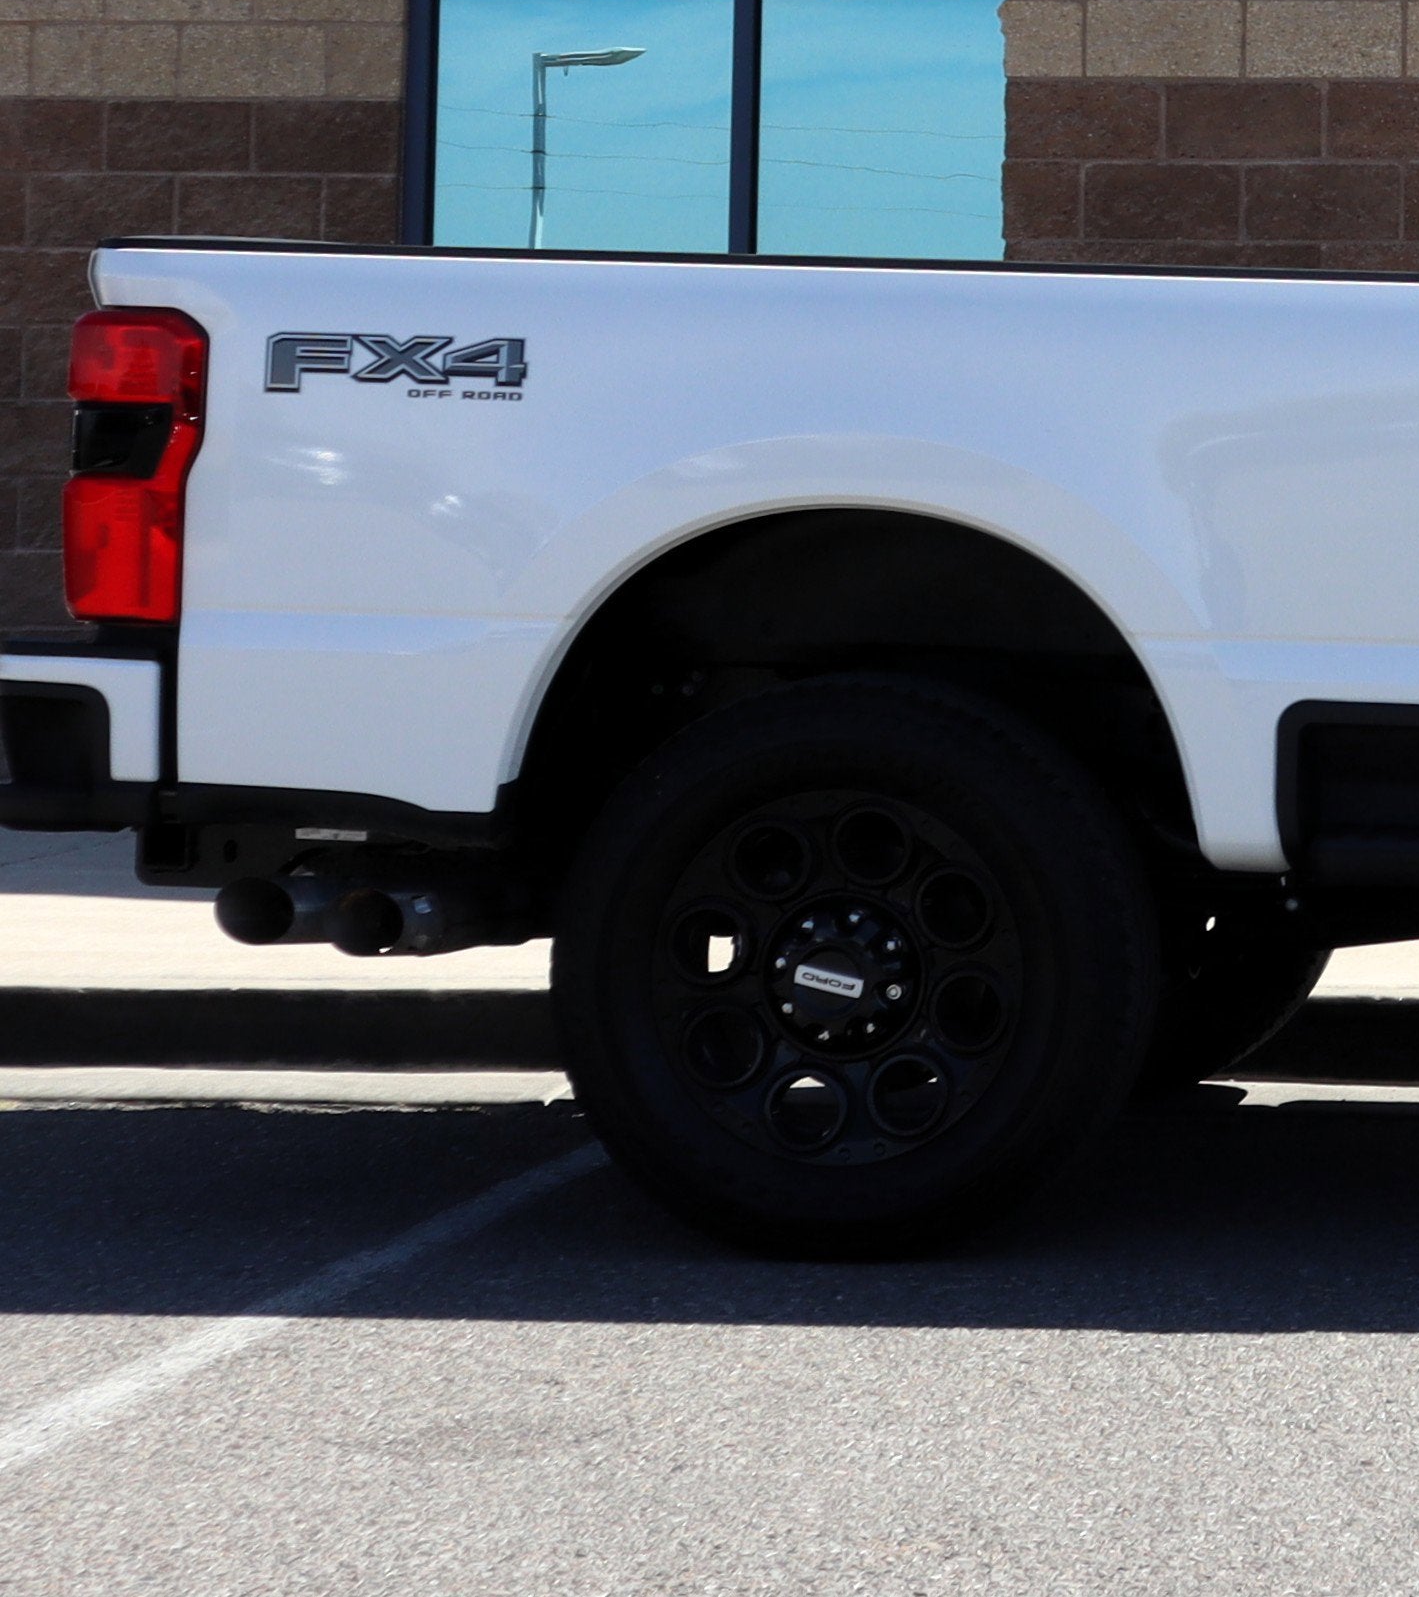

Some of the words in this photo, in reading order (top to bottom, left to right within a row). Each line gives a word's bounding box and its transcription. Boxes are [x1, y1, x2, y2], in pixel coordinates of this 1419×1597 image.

[264, 332, 527, 393] FX4
[407, 389, 452, 399] OFF
[461, 390, 523, 401] ROAD
[801, 971, 856, 991] FORD
